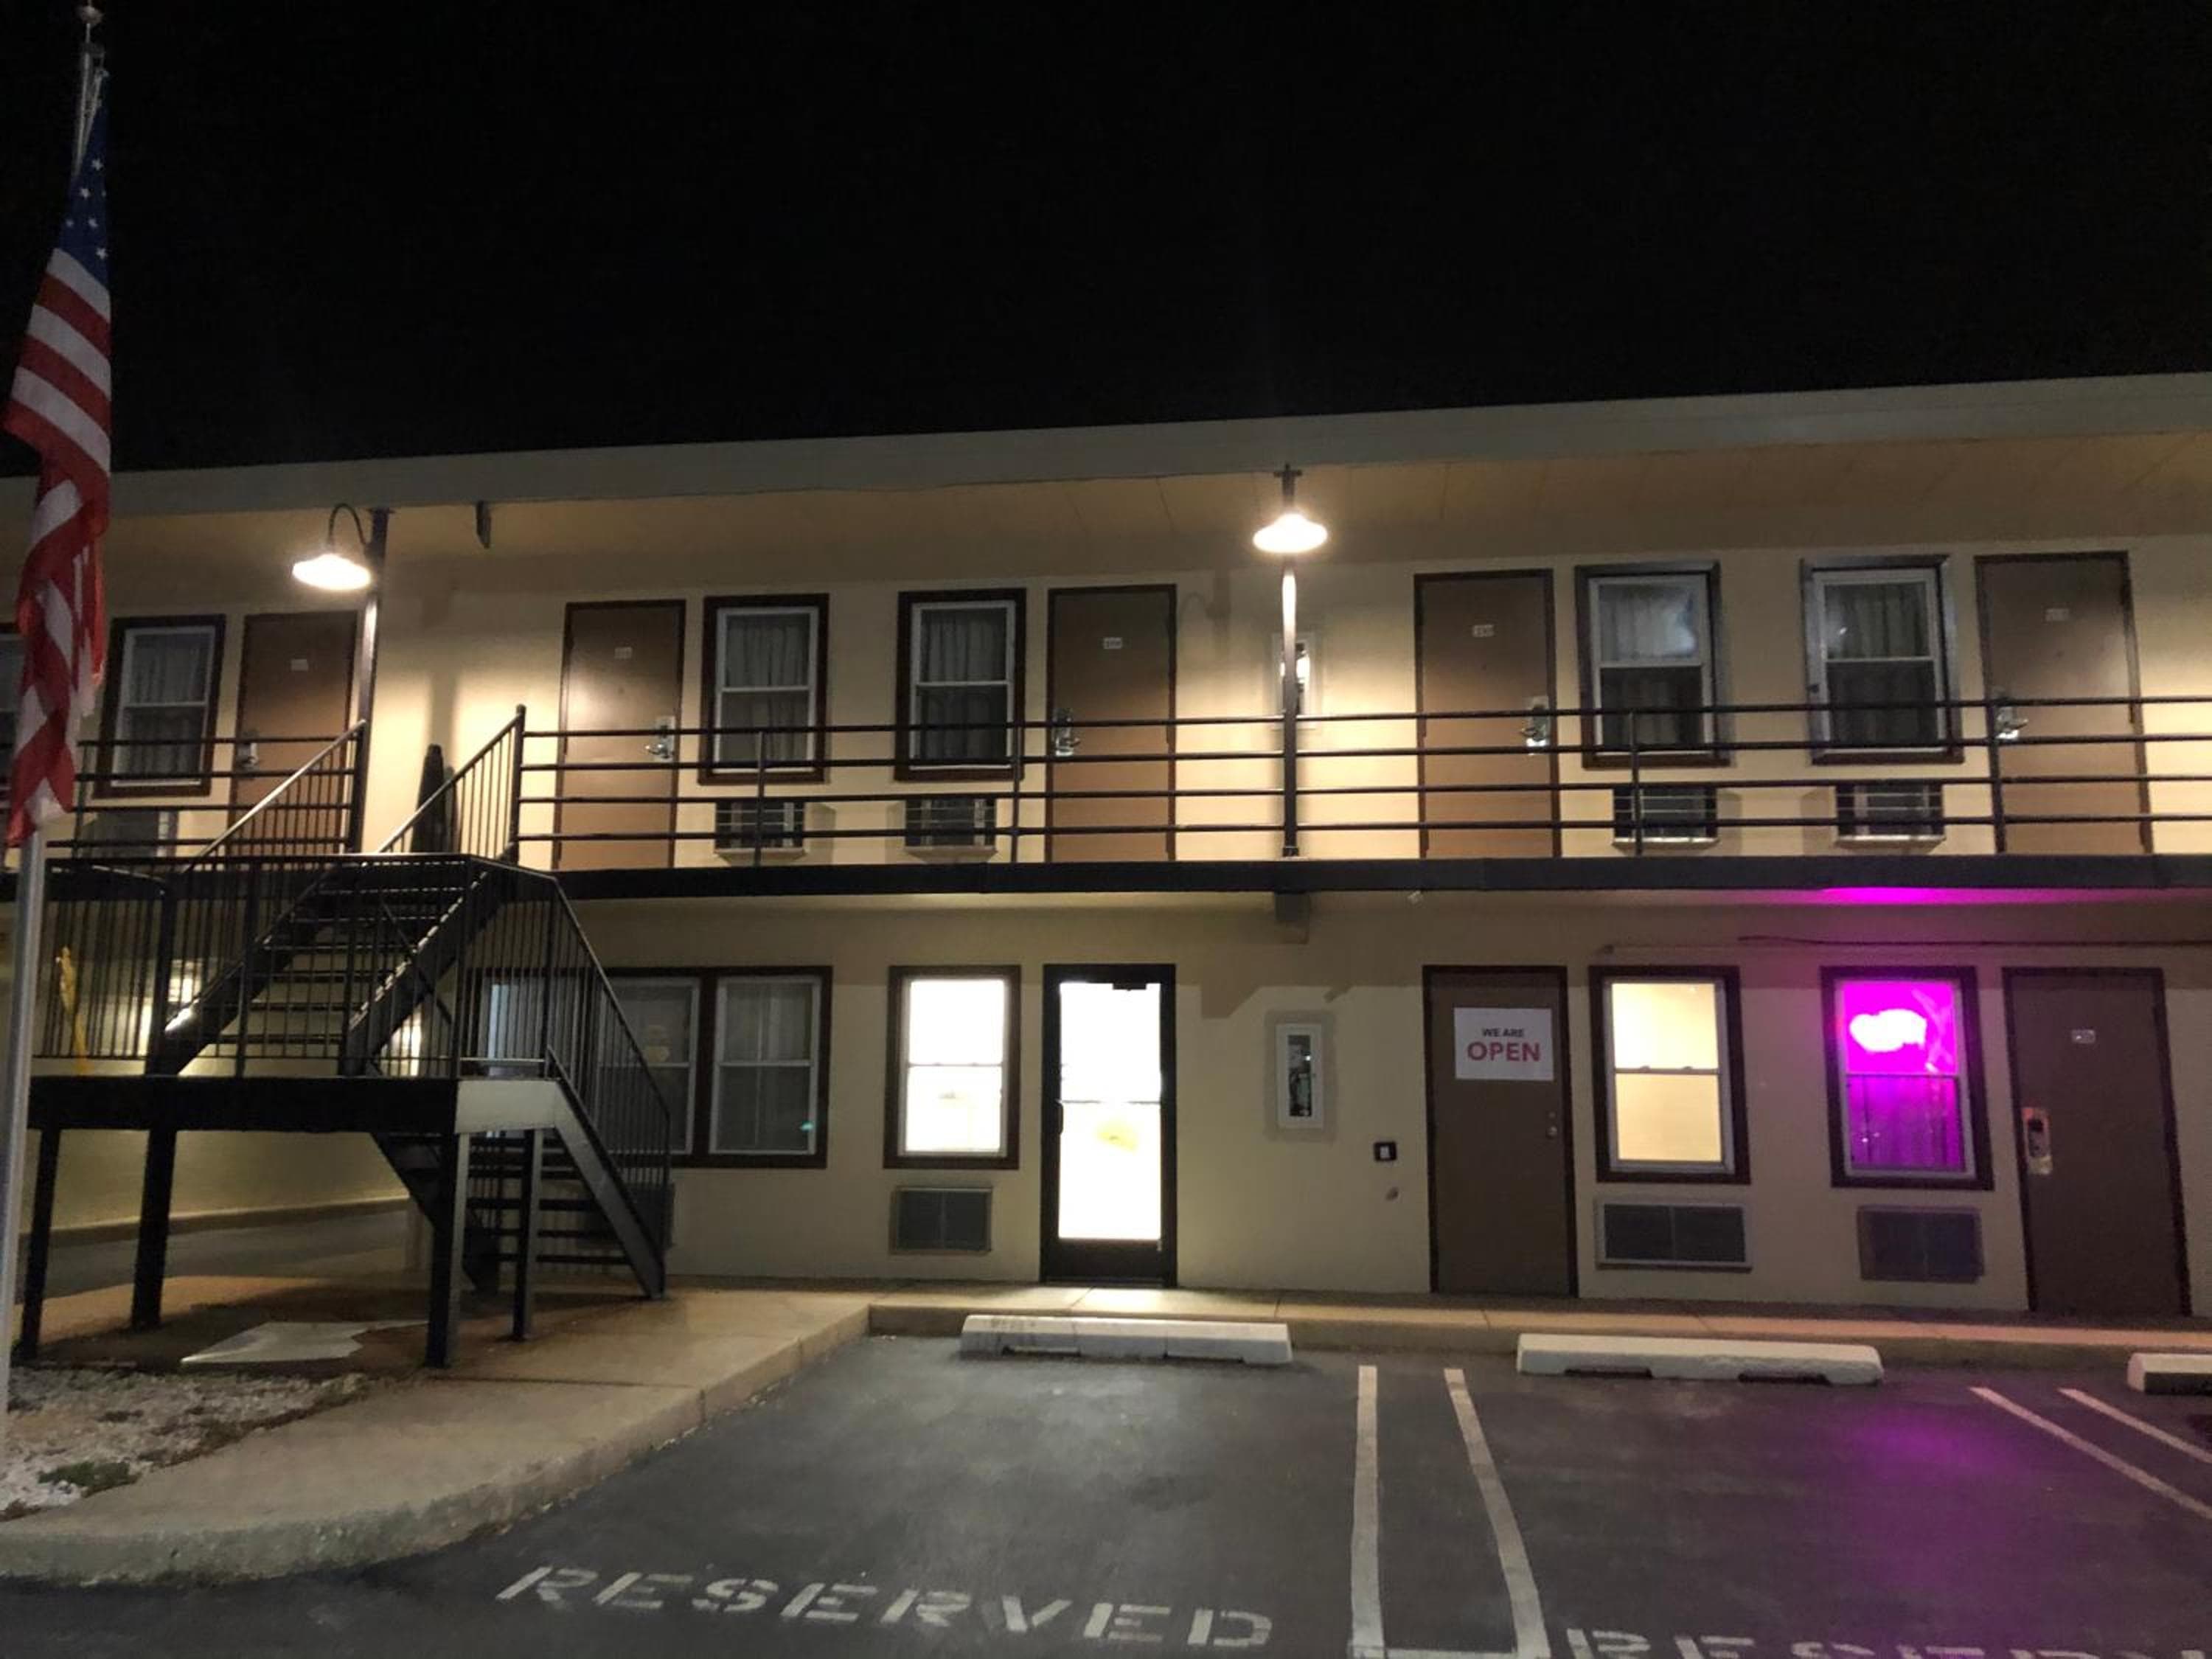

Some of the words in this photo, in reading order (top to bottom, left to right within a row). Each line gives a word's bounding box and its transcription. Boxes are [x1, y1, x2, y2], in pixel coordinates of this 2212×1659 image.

[1483, 1028, 1500, 1037] WE
[1503, 1028, 1524, 1037] ARE
[1467, 1041, 1540, 1061] OPEN
[495, 1565, 1273, 1647] RESERVED
